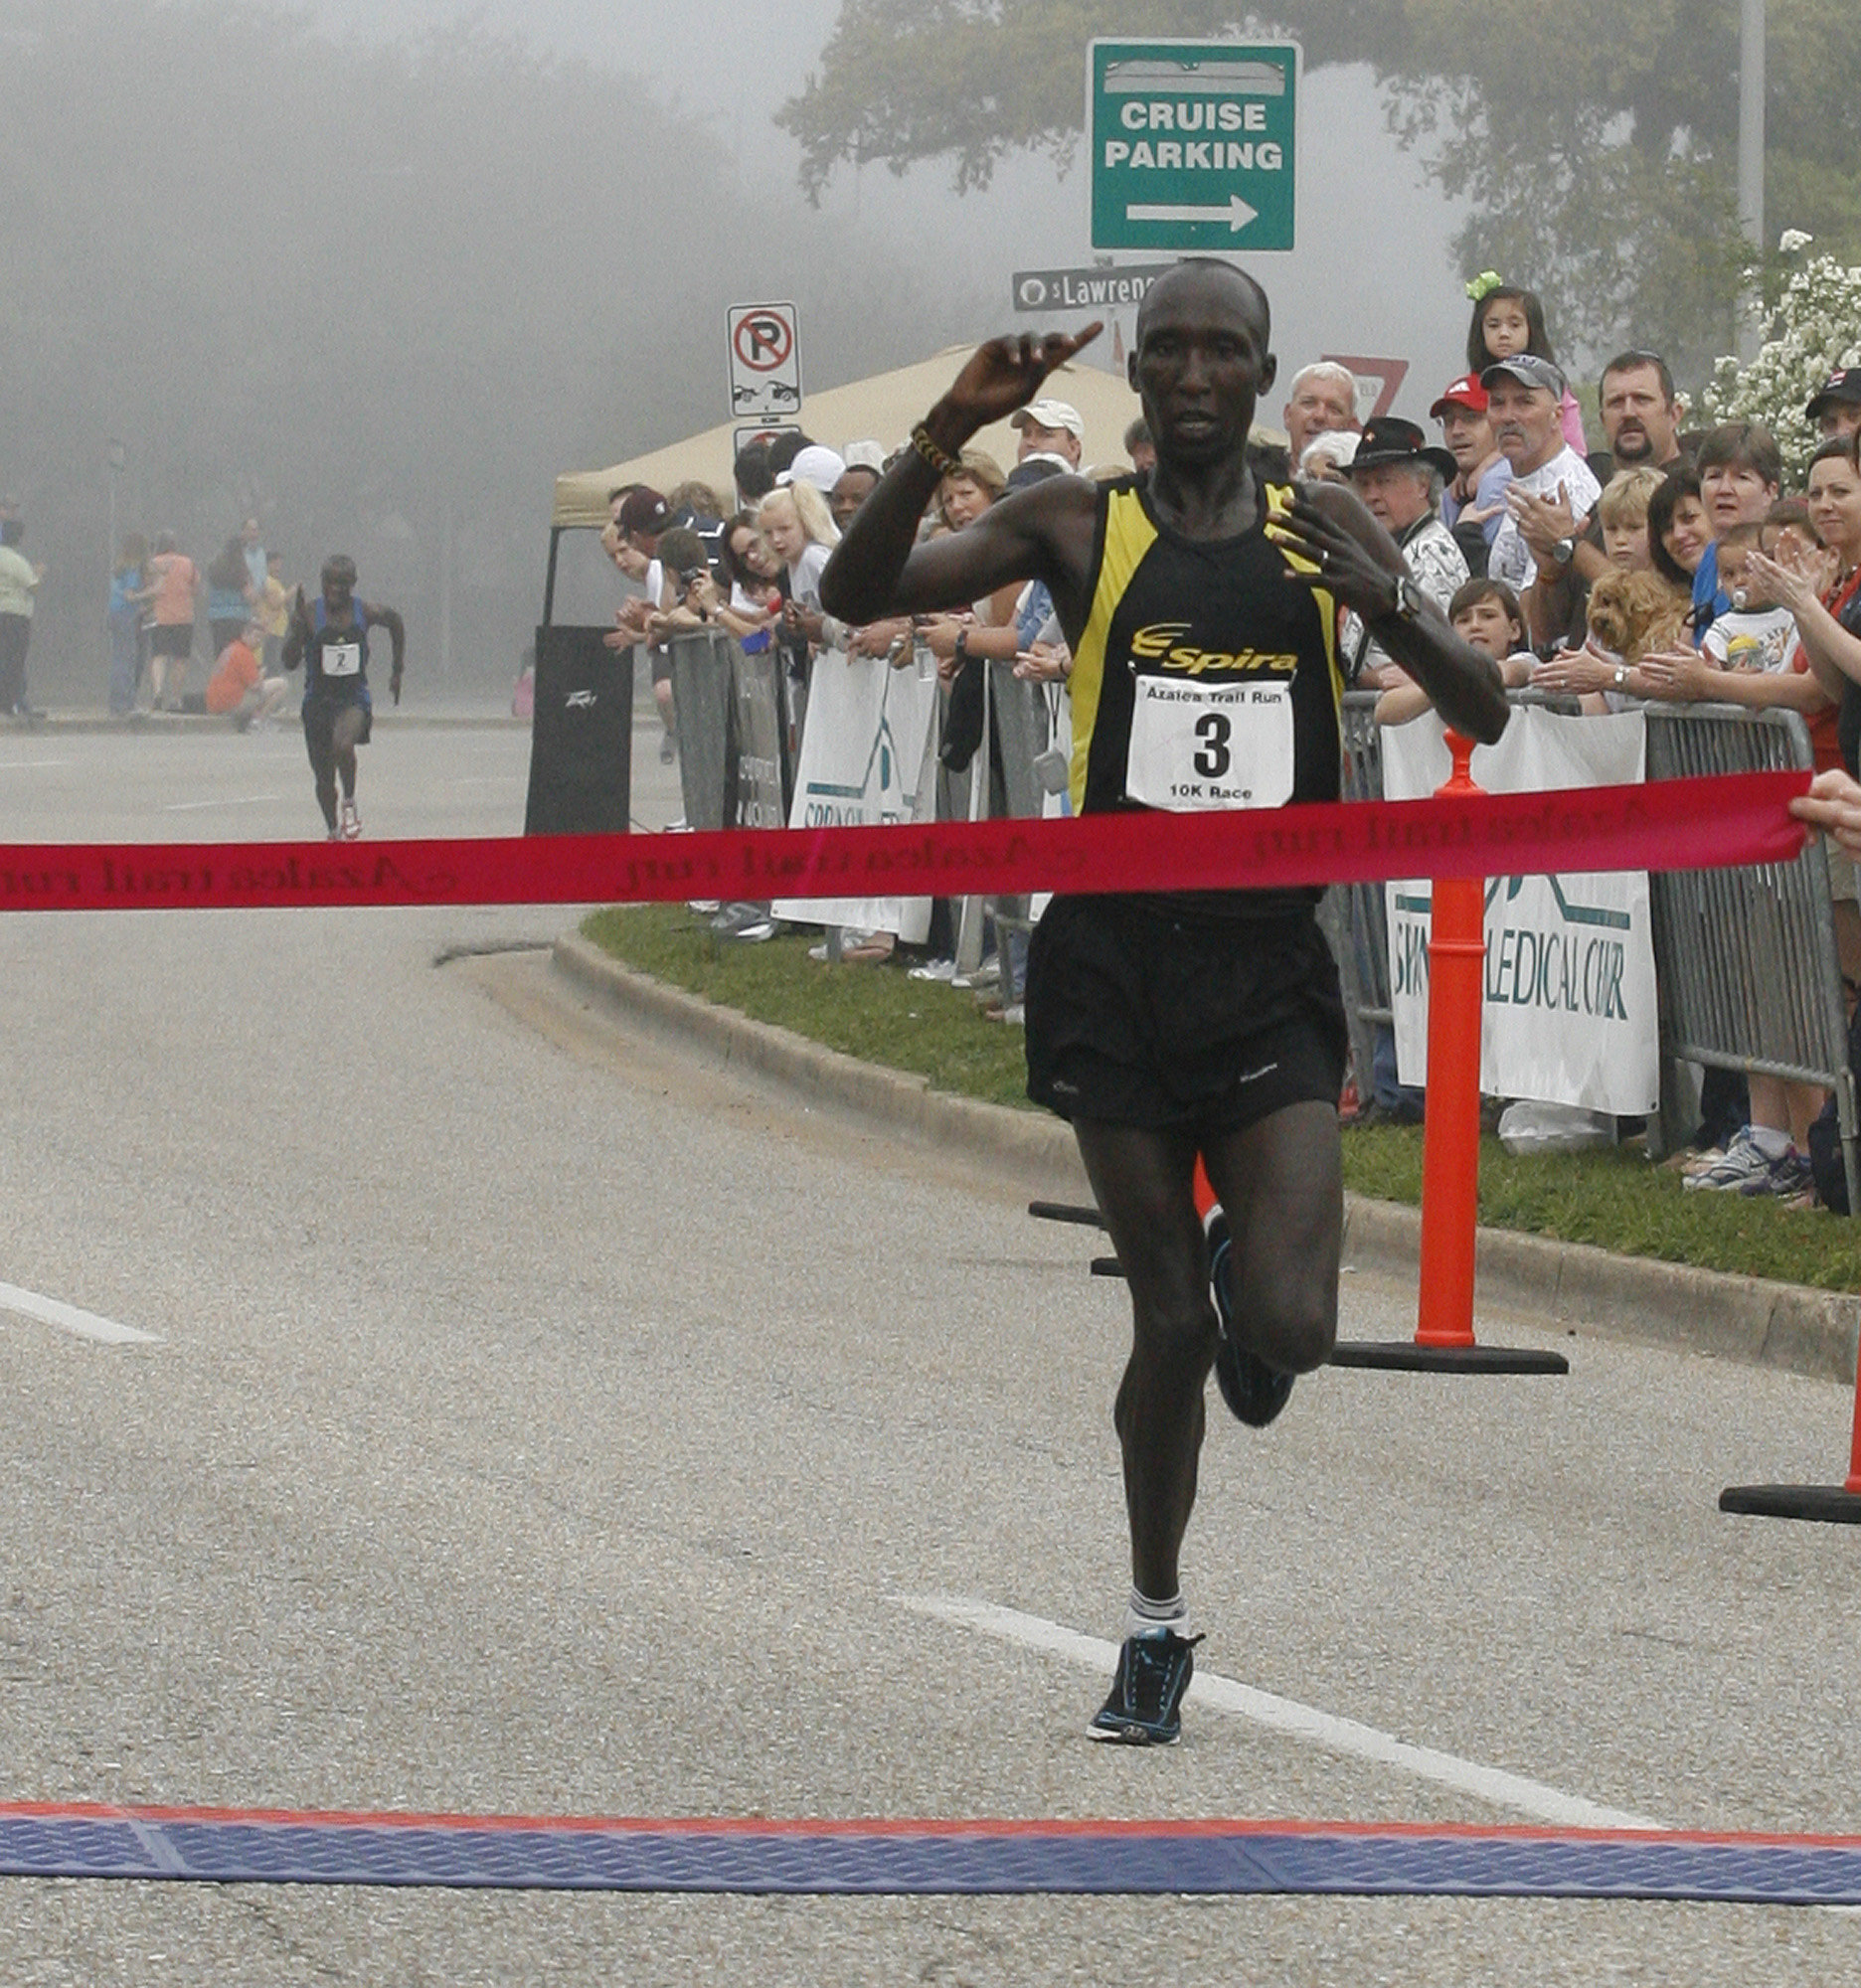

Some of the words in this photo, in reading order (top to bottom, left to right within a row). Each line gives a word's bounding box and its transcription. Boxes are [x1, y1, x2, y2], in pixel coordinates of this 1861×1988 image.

[1120, 102, 1267, 131] CRUISE
[1104, 141, 1282, 170] PARKING
[1146, 686, 1202, 704] Azalea
[1209, 691, 1245, 703] Trail
[1252, 691, 1281, 704] Run
[1194, 713, 1231, 778] 3
[1170, 784, 1203, 798] 10K
[1209, 785, 1253, 799] Race
